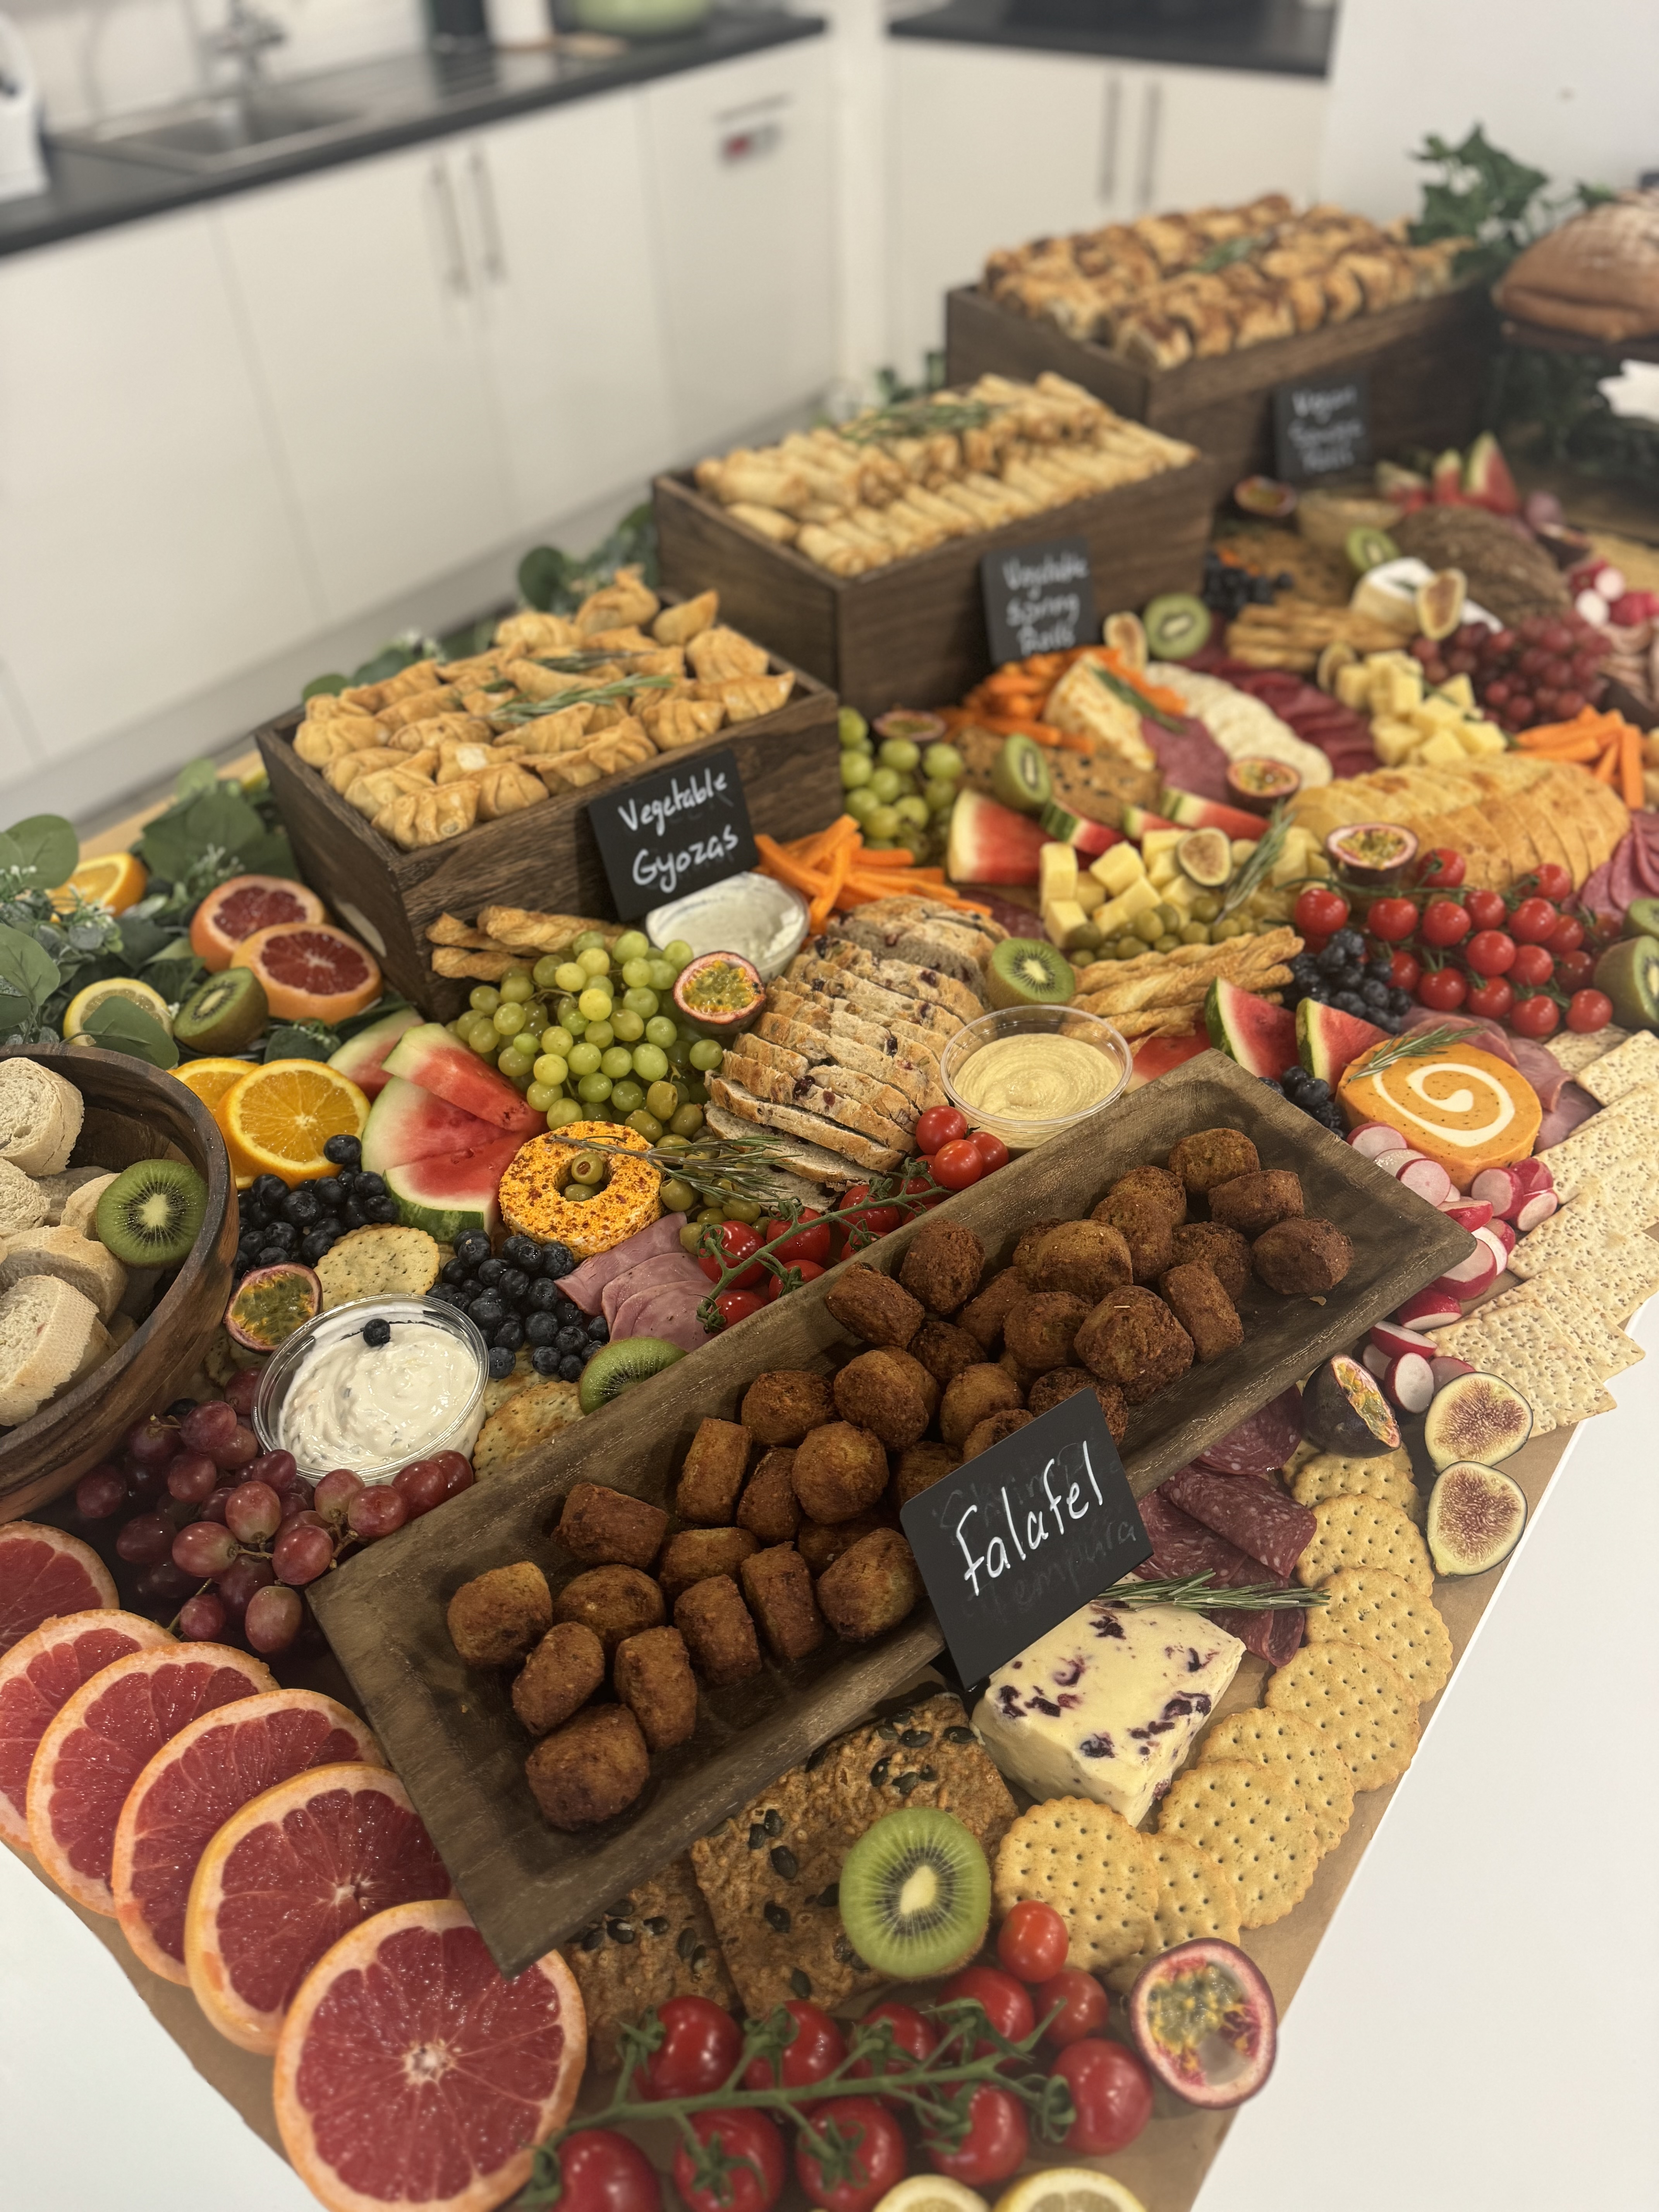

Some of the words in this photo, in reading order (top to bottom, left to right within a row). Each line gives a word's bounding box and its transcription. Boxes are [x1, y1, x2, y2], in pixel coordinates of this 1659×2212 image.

[1002, 551, 1090, 600] Vegetable
[618, 768, 728, 836] Vegetable
[632, 824, 739, 893] Gyozas
